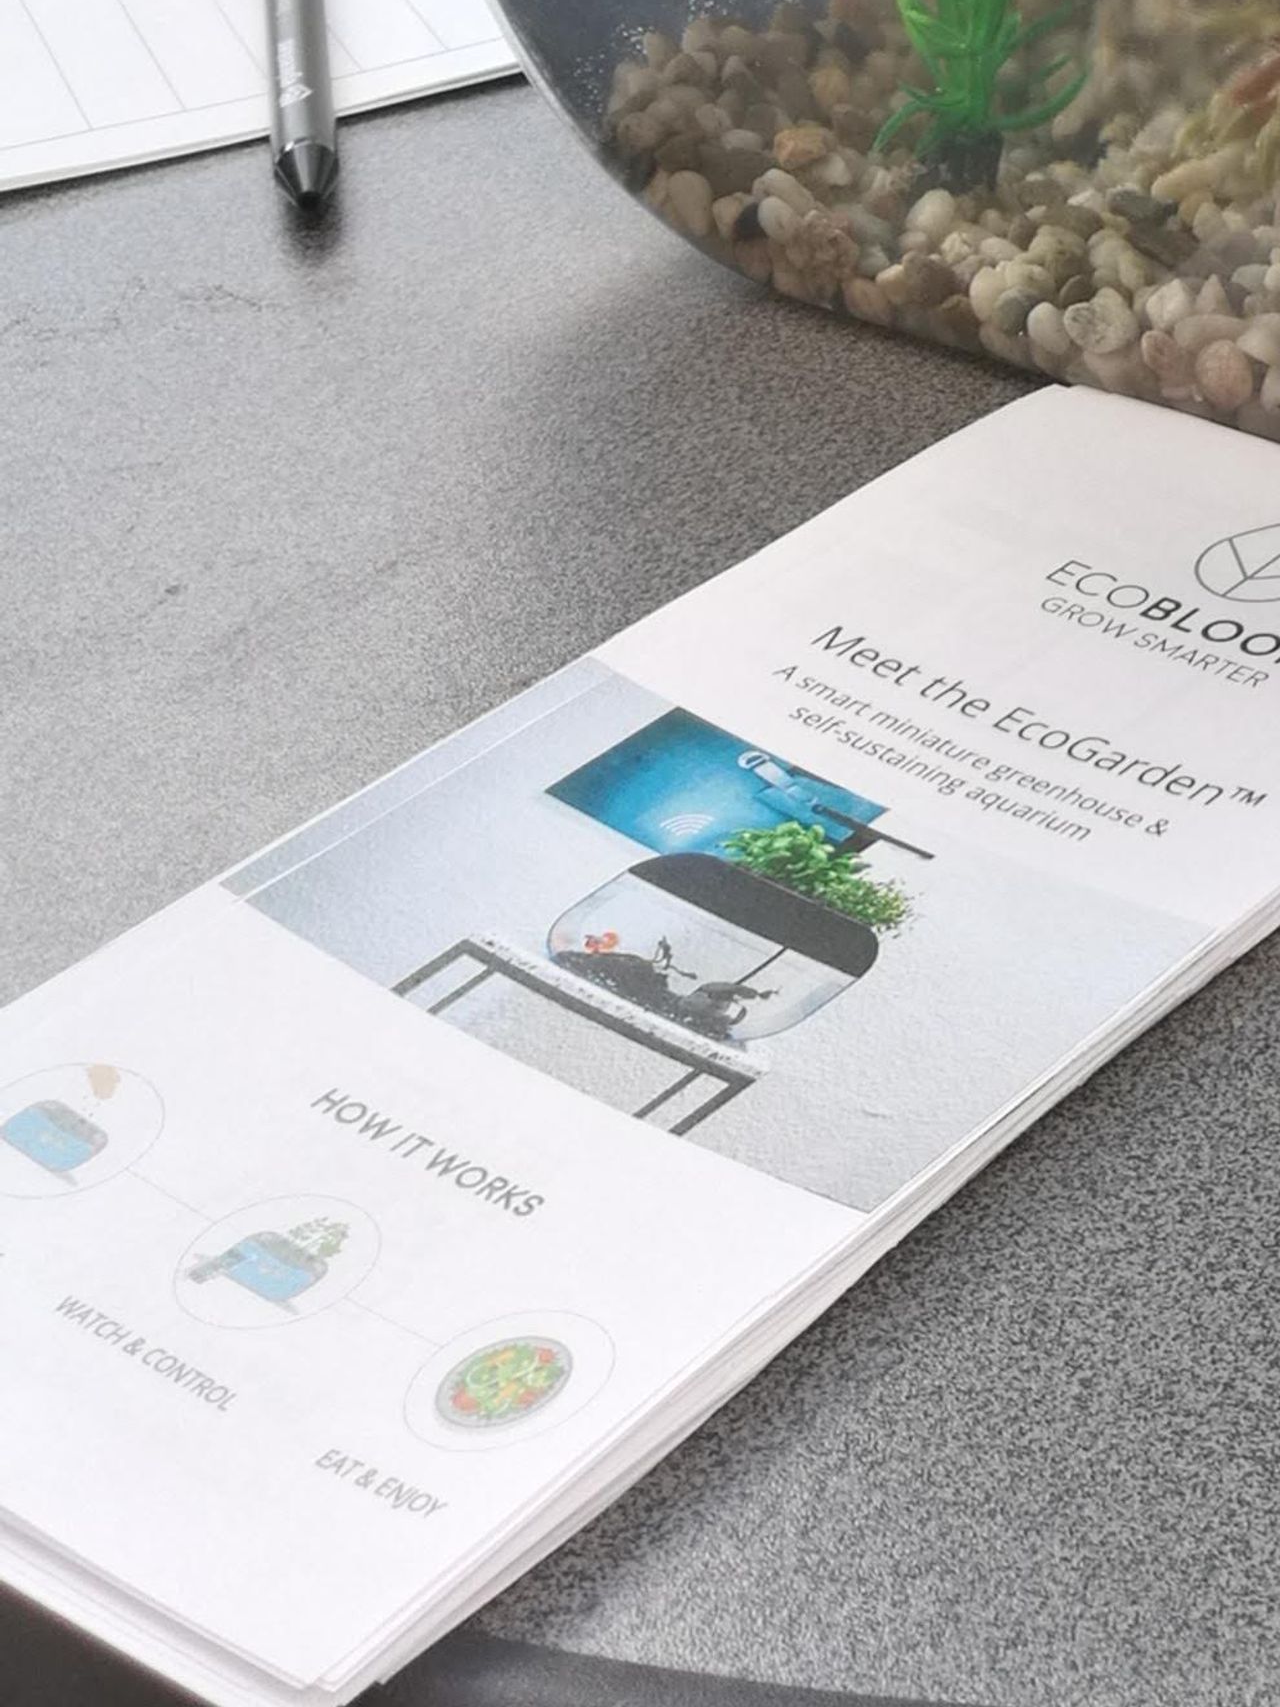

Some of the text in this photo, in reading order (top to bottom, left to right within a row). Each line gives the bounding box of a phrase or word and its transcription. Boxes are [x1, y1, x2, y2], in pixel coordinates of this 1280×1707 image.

[810, 623, 924, 695] Meet
[926, 671, 992, 722] the
[1039, 594, 1271, 690] GROW SMARTER
[773, 662, 1171, 839] A smart miniature greenhouse &
[787, 703, 1093, 843] self-sustaining aquarium
[310, 1086, 546, 1219] HOW IT WORKS
[56, 1294, 239, 1413] WATCH & CONTROL
[315, 1447, 449, 1520] EAT & ENJOY
